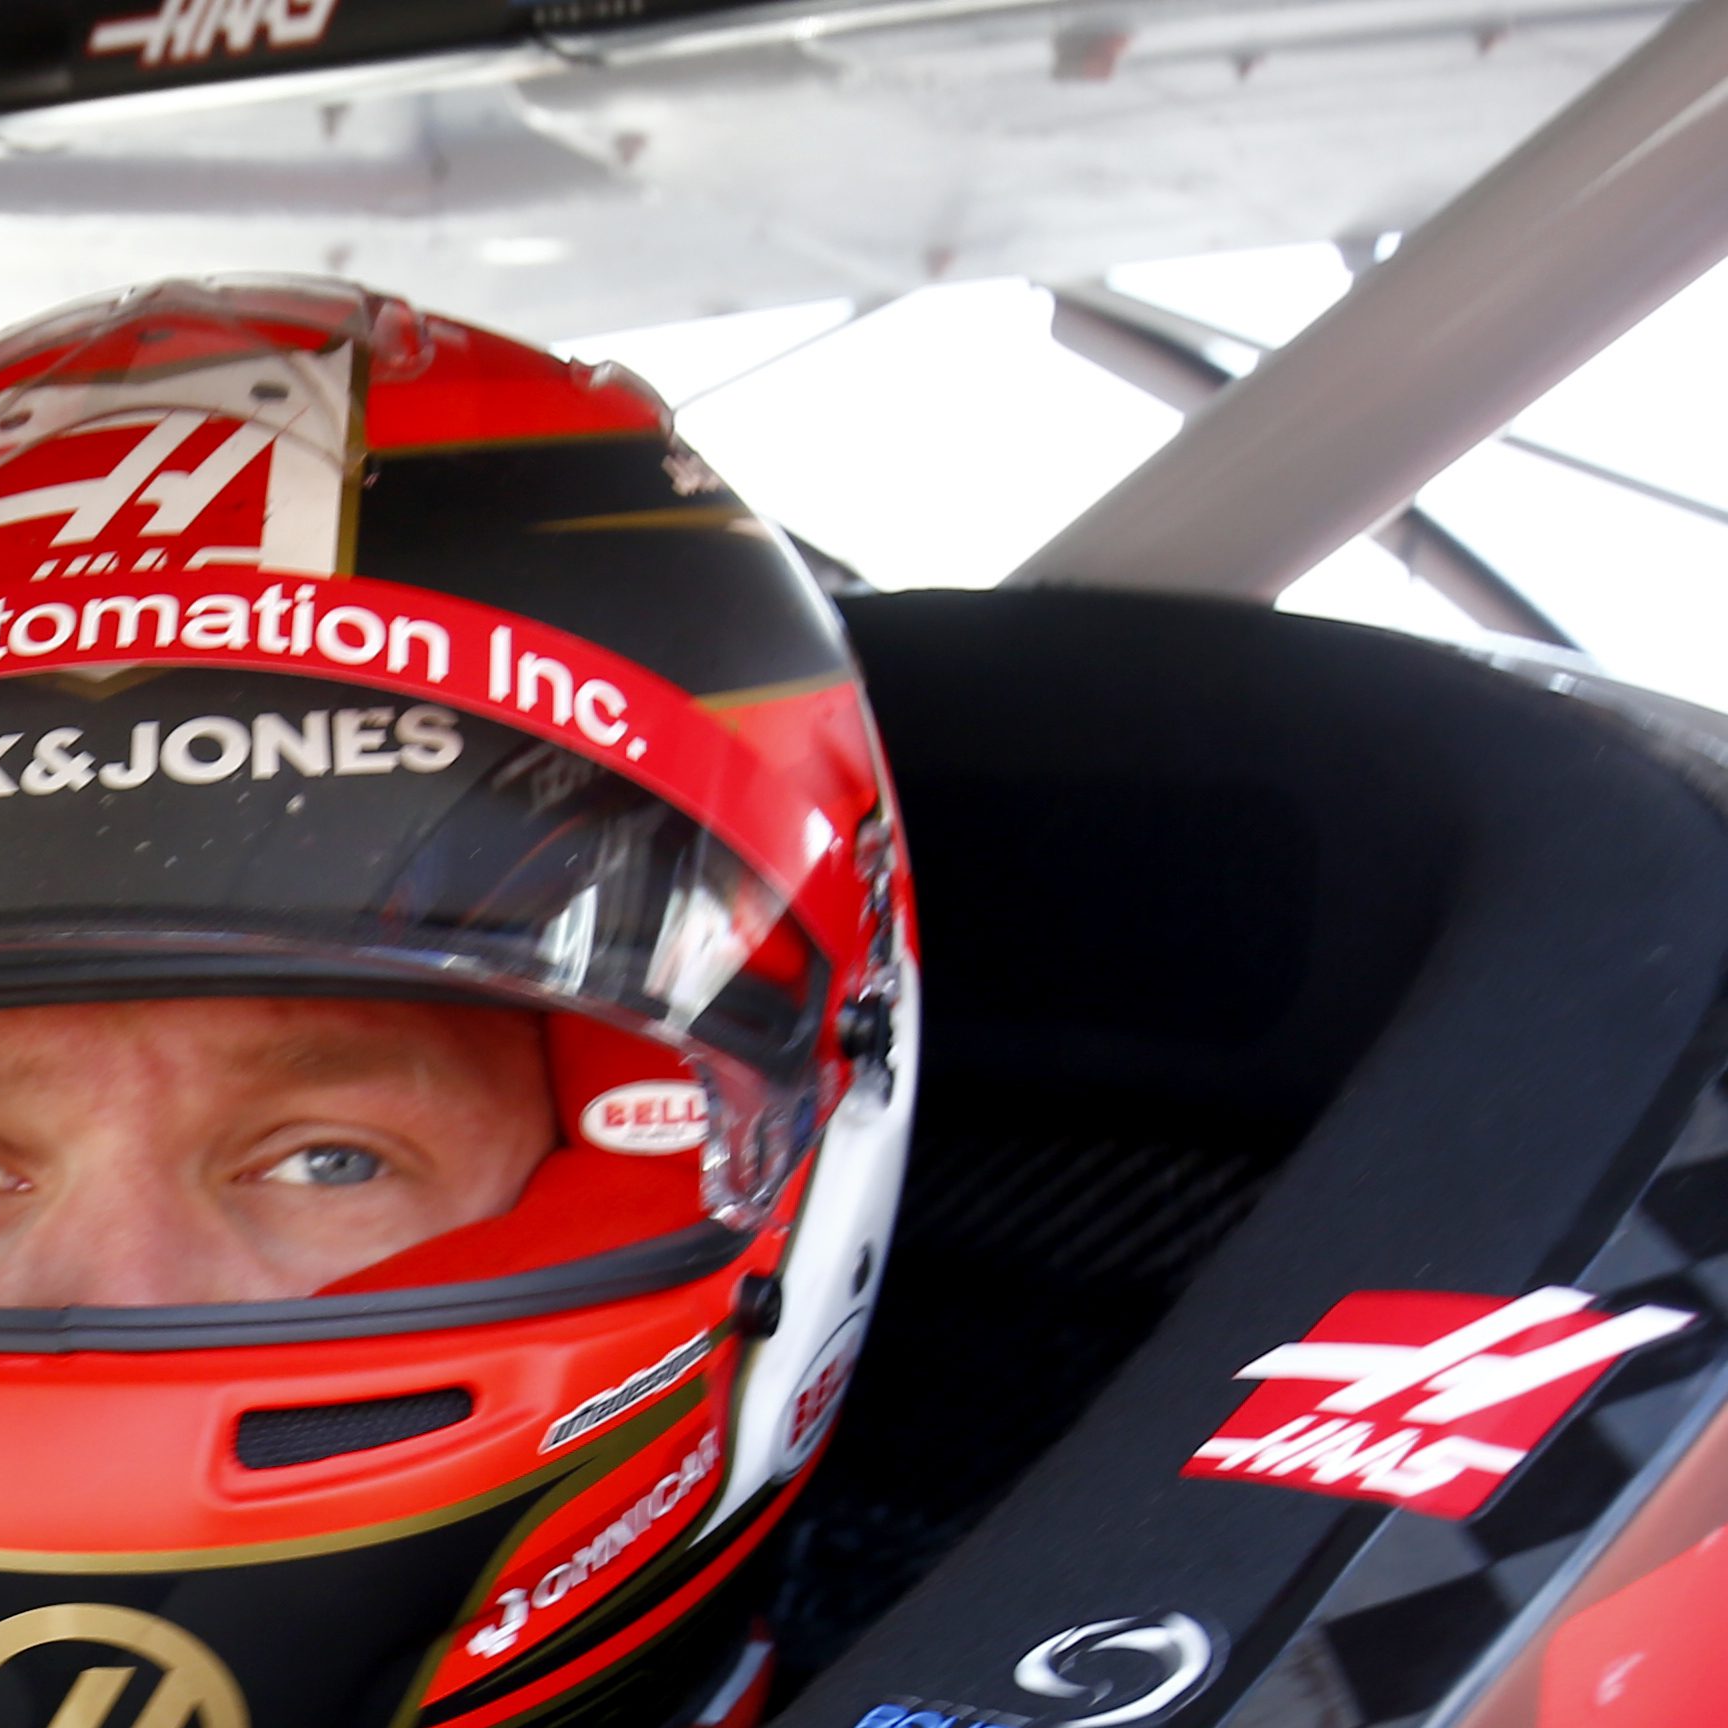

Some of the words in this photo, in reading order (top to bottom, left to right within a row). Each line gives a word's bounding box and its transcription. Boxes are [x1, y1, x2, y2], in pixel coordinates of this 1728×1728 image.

[488, 624, 647, 762] Inc.
[605, 1097, 708, 1127] BELL
[1192, 1414, 1530, 1500] HAAS
